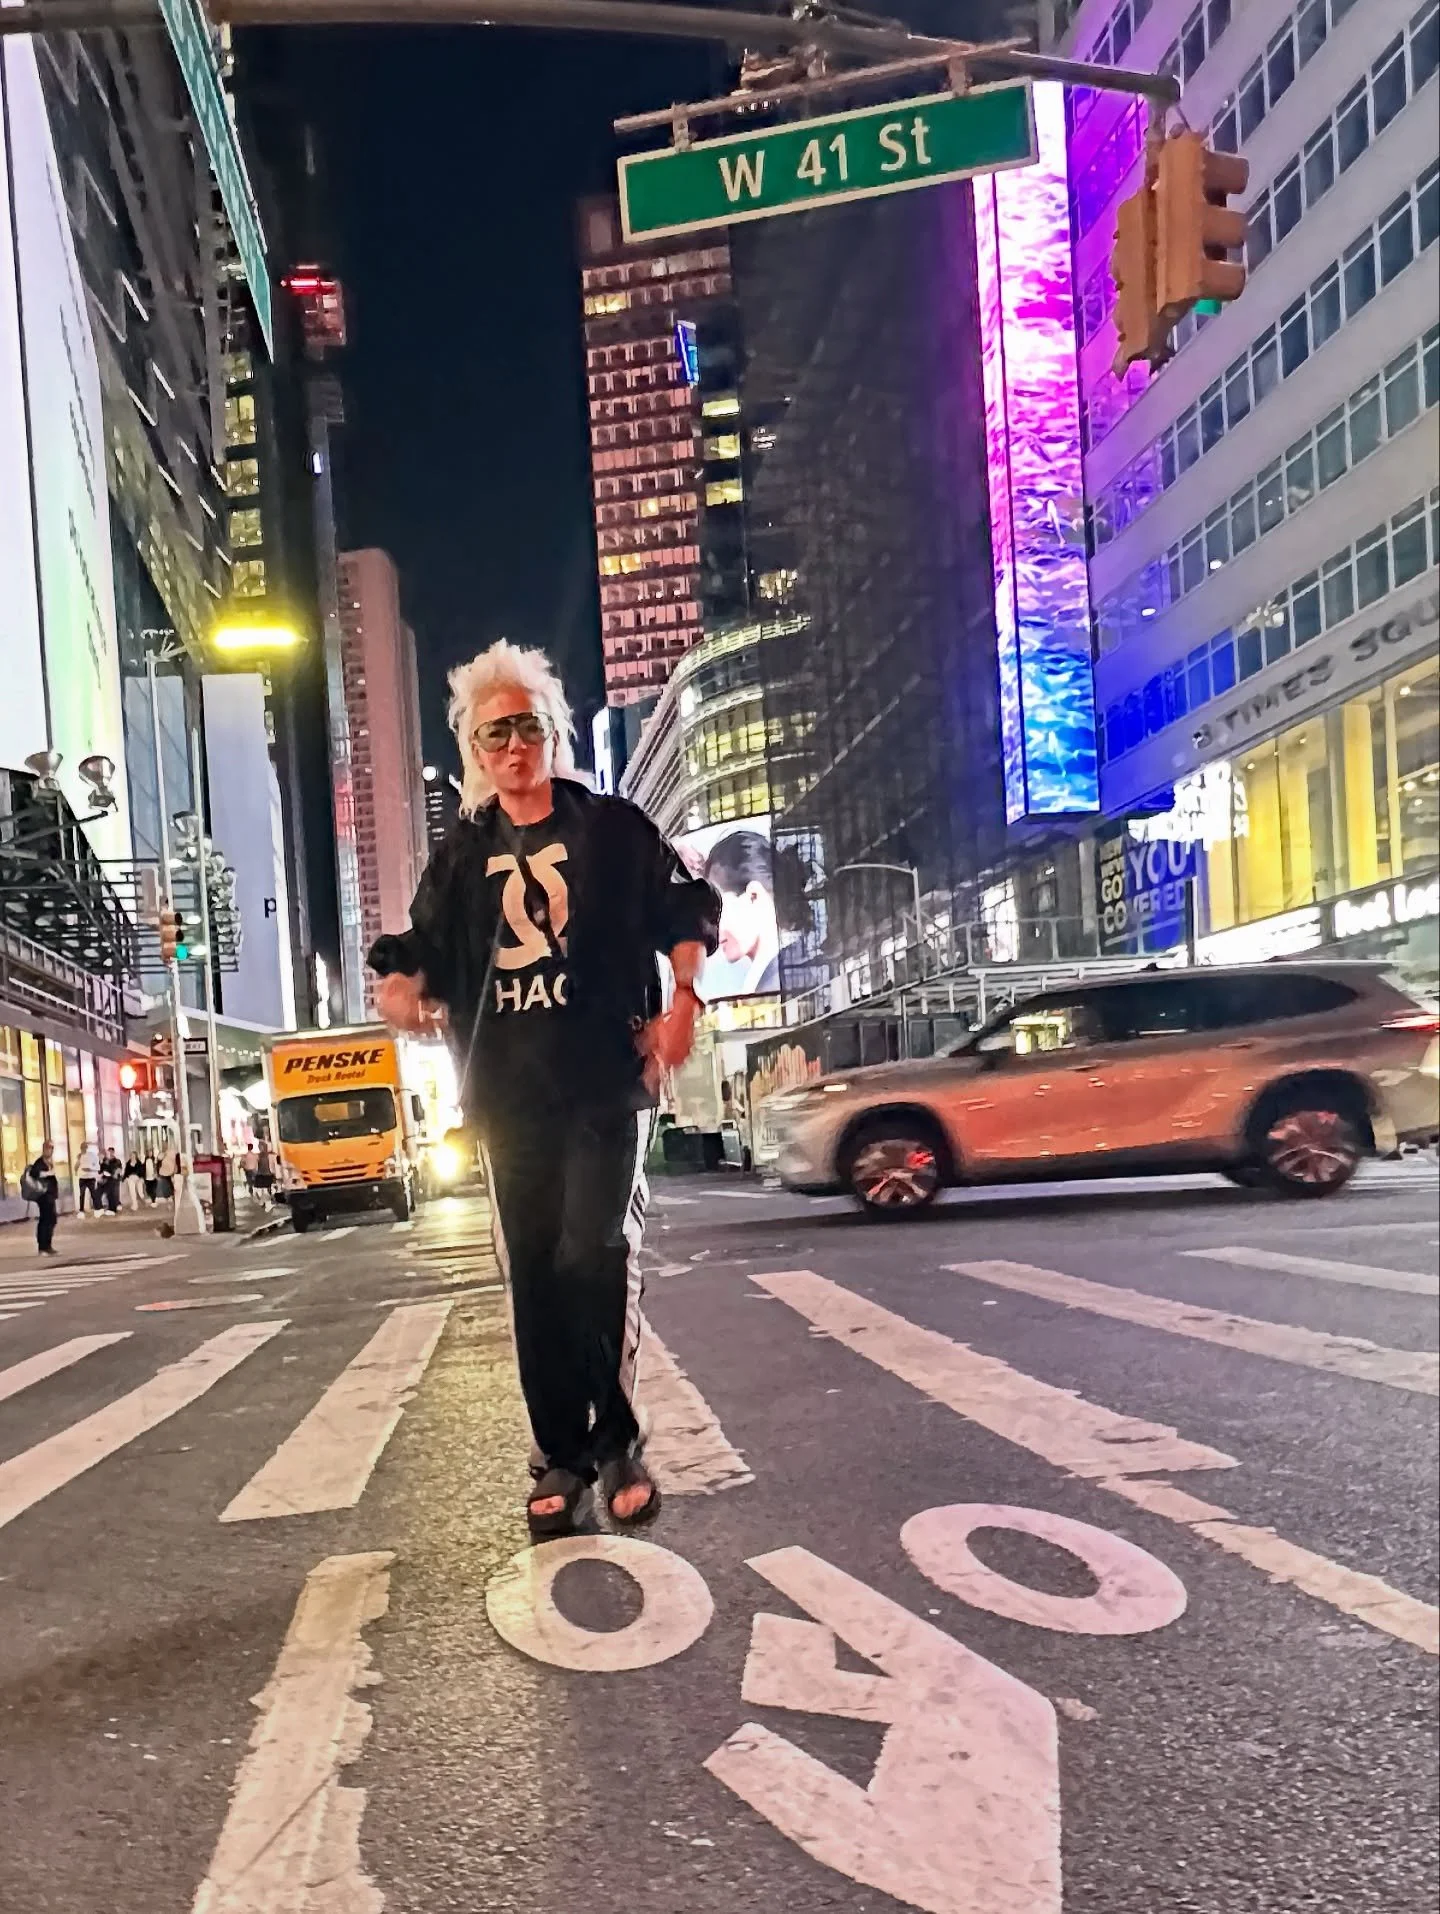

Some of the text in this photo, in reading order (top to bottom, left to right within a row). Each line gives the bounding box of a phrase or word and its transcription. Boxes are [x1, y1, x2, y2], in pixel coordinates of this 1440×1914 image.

[719, 117, 931, 202] W 41 St
[1216, 654, 1335, 733] TIMES
[1128, 838, 1187, 890] YOU
[284, 1048, 385, 1074] PENSKE
